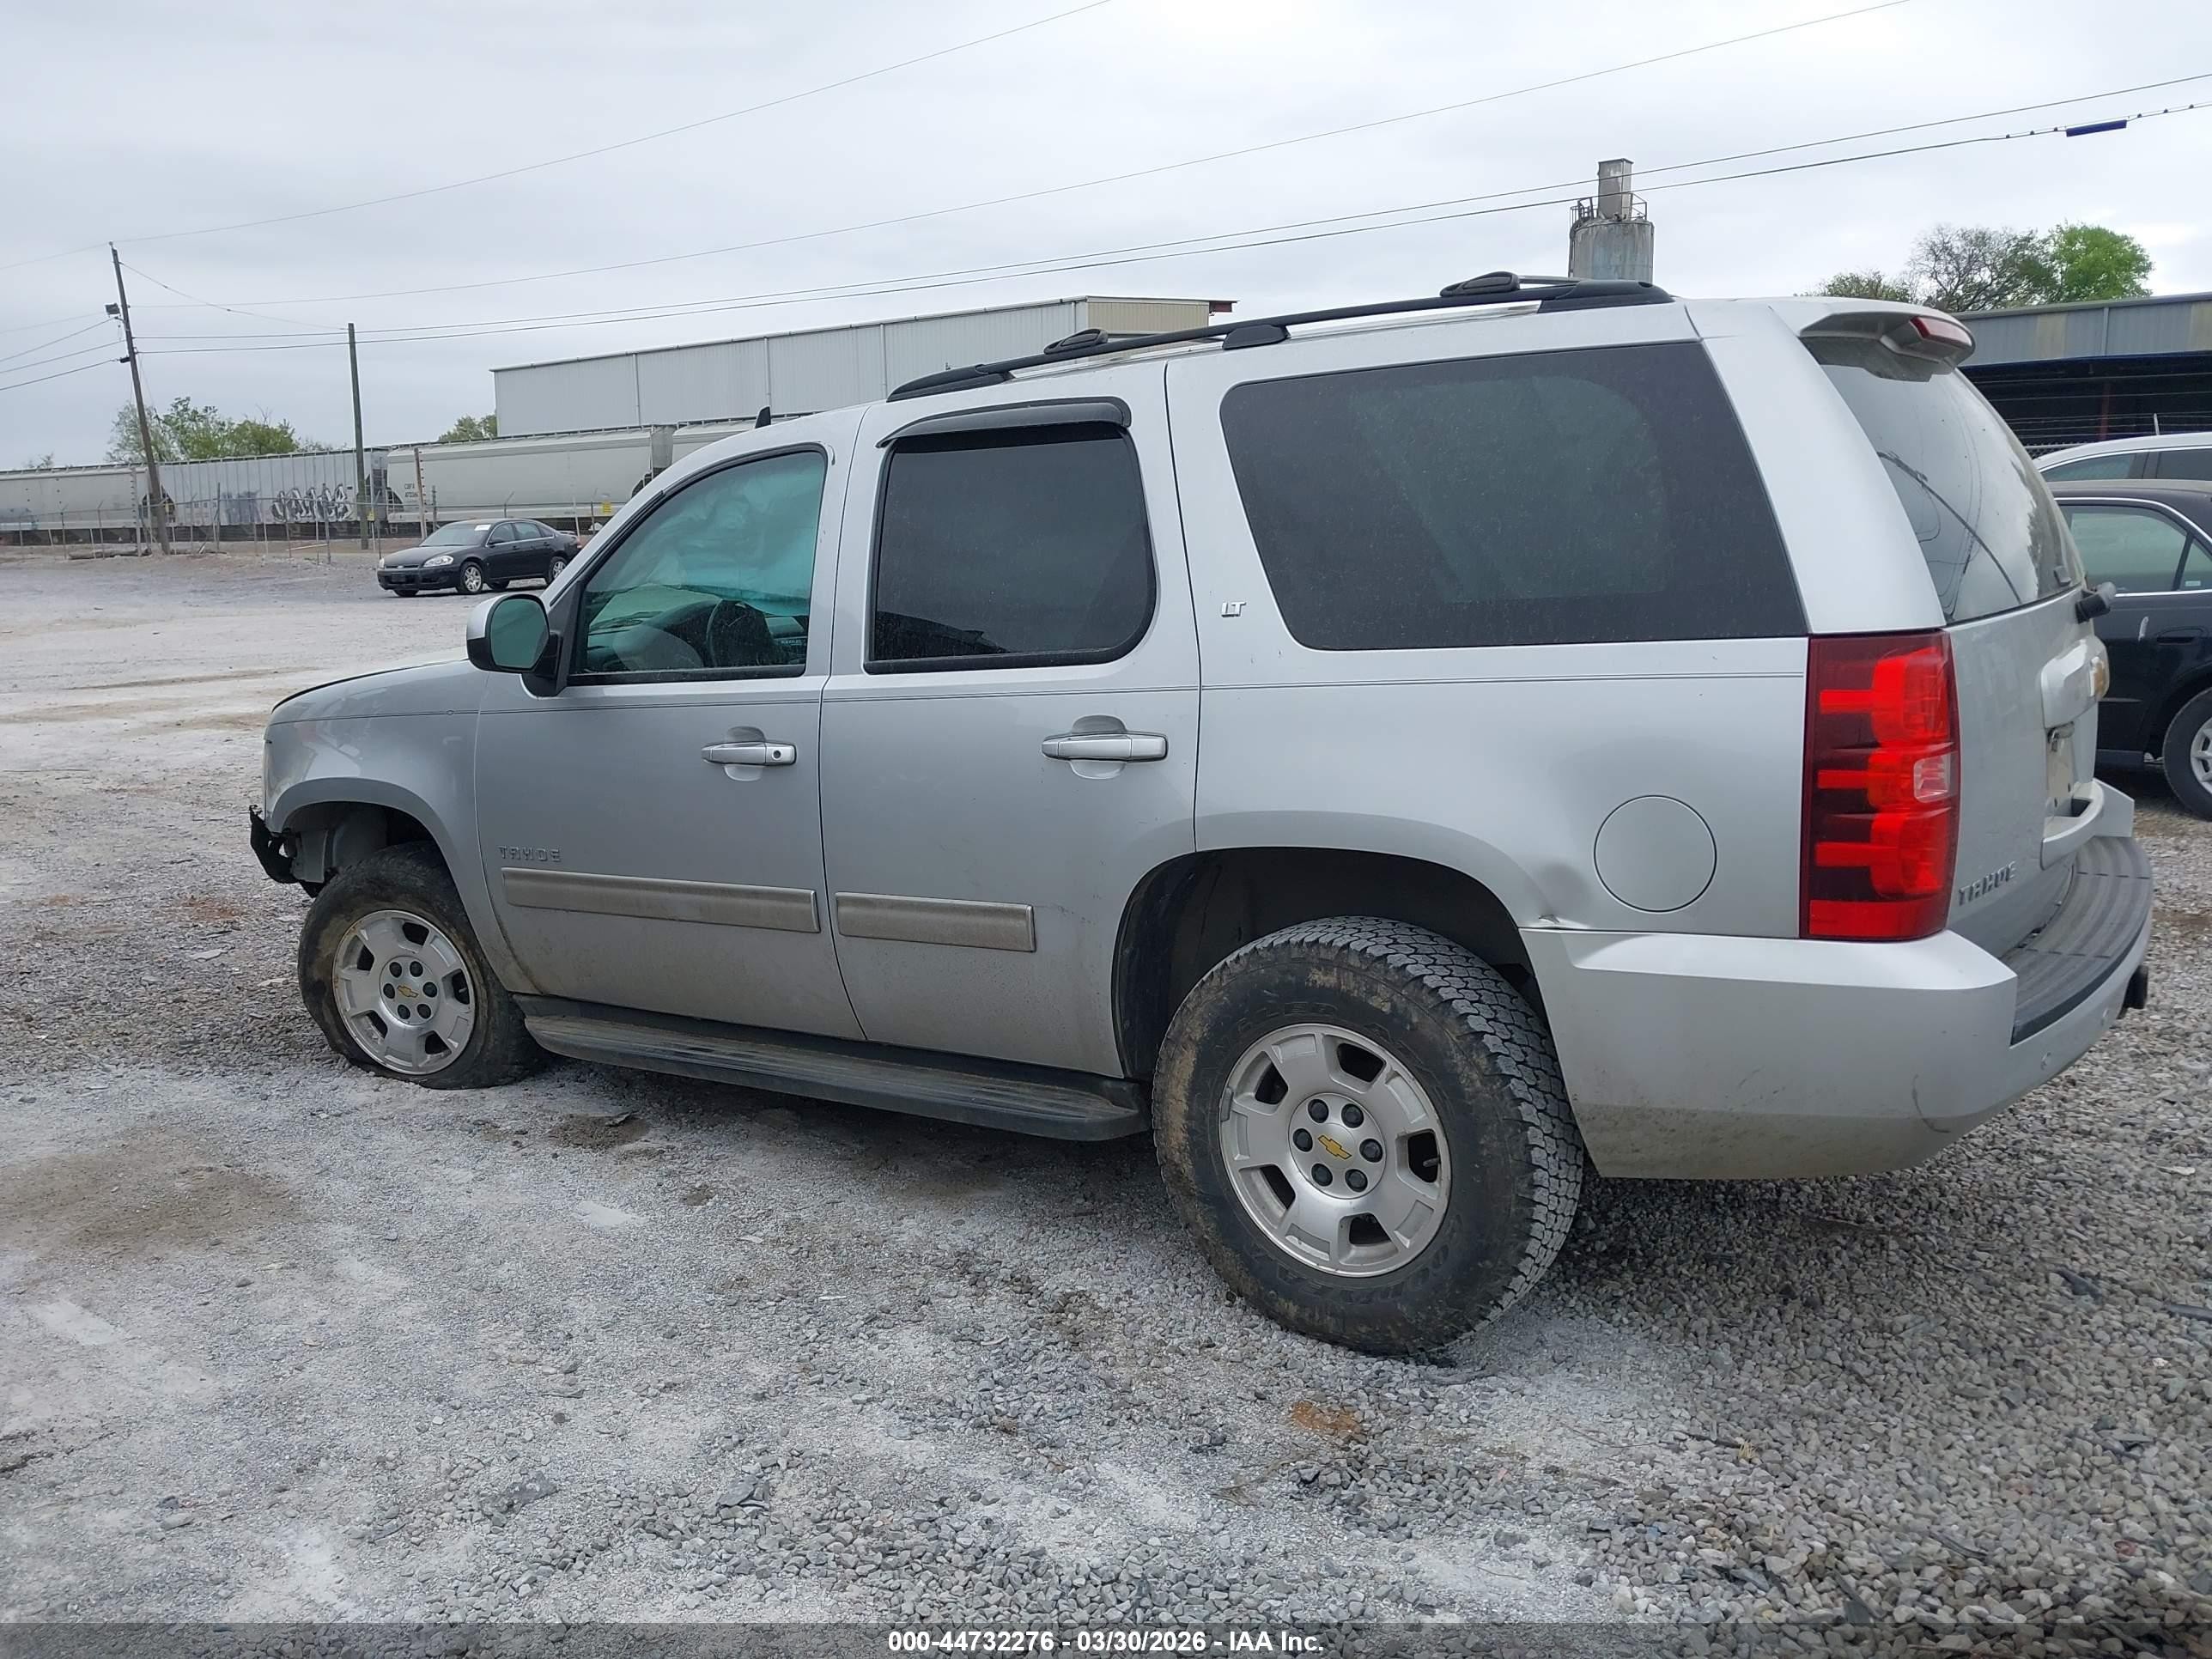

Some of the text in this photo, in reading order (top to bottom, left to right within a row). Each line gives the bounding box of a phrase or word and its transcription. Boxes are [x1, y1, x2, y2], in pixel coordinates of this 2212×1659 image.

[1221, 601, 1246, 617] LT
[497, 845, 562, 862] TAHOE
[1959, 860, 2016, 906] TAHOE
